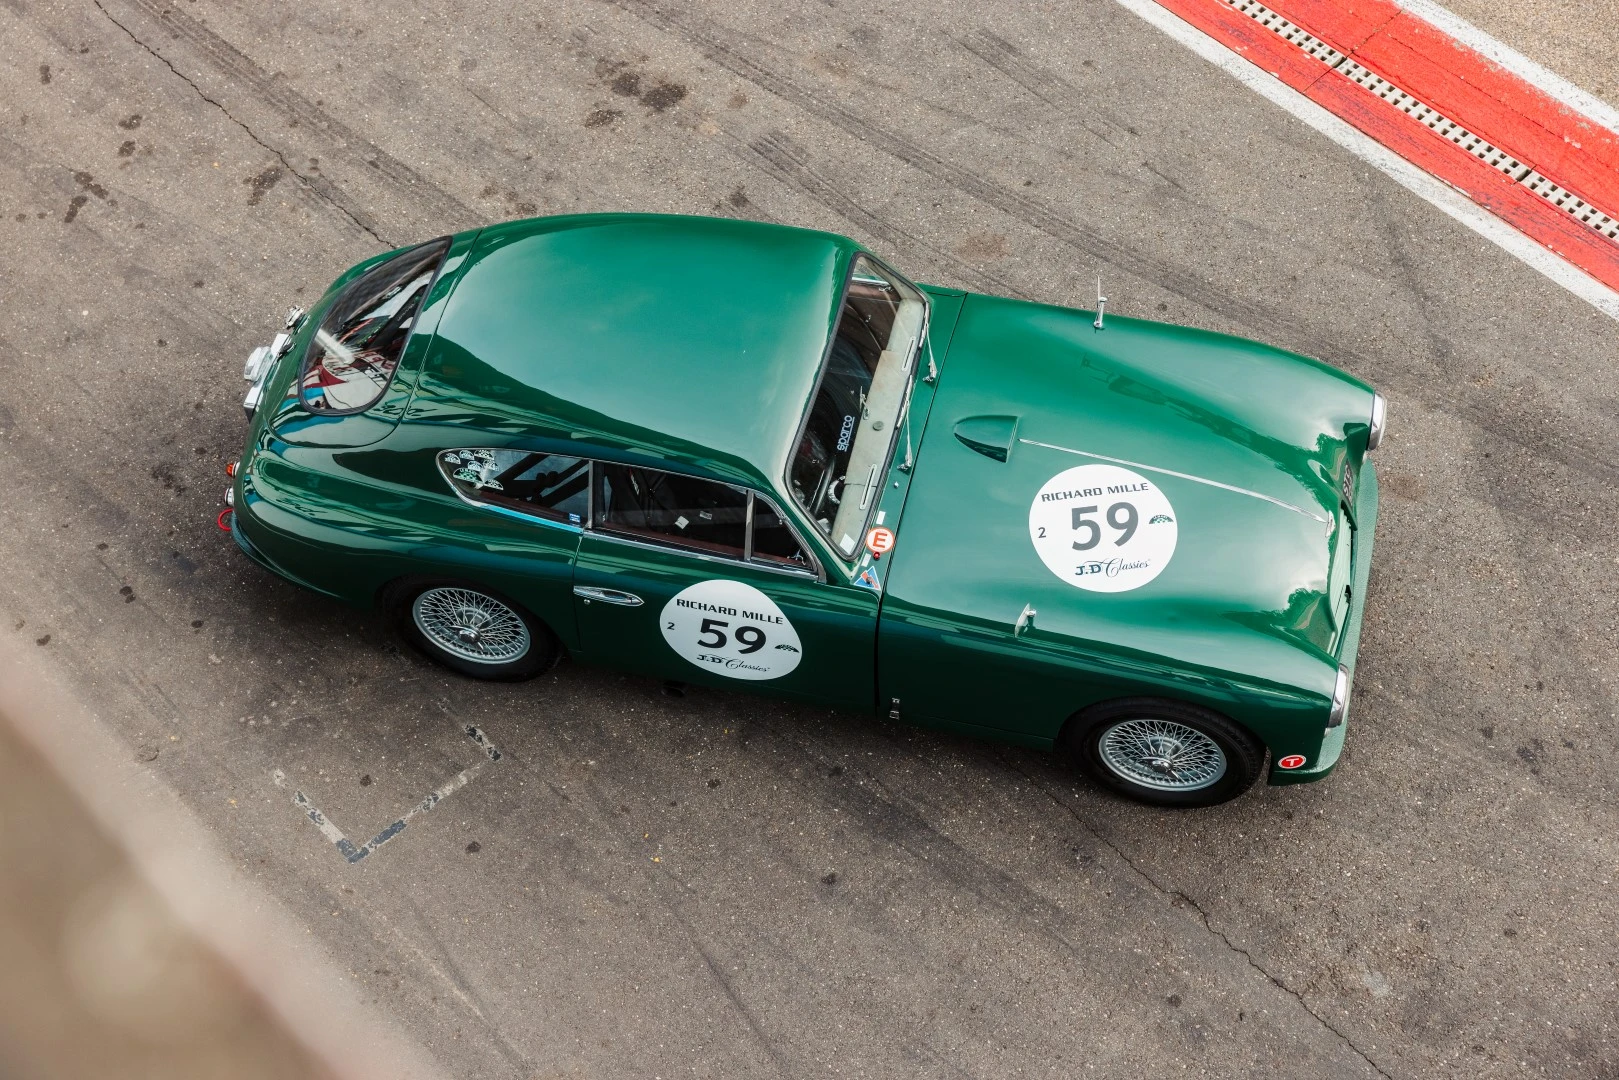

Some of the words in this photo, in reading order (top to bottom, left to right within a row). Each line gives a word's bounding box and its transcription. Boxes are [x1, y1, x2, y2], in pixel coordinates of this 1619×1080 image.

[837, 415, 854, 452] sparco
[1041, 487, 1103, 503] RICHARD
[1107, 482, 1149, 495] MILLE
[1038, 526, 1047, 539] 2
[1071, 501, 1139, 551] 59
[872, 531, 888, 549] E
[1105, 557, 1150, 578] Classics
[676, 598, 737, 616] RICHARD
[742, 610, 783, 624] MILLE
[666, 621, 675, 631] 2
[697, 618, 767, 655] 59
[725, 658, 768, 672] Classics
[1286, 758, 1299, 767] T
